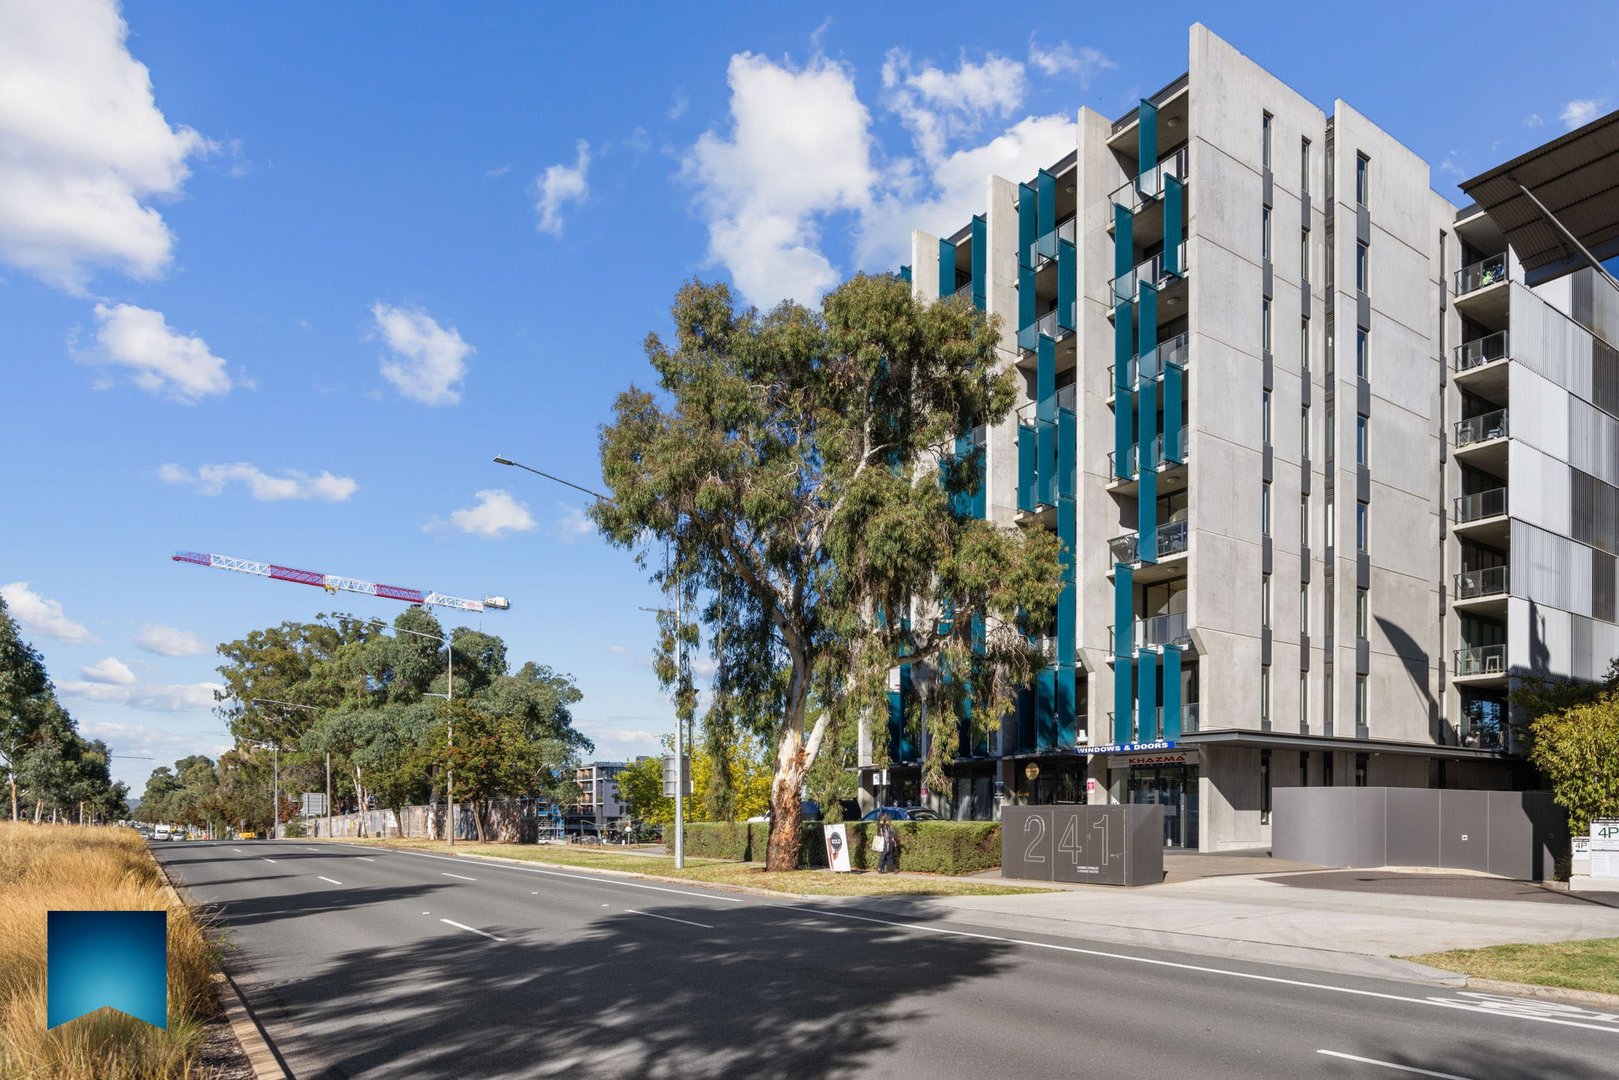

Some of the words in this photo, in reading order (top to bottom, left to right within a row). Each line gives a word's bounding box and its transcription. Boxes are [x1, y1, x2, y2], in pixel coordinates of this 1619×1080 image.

[1077, 745, 1121, 753] WINDOWS
[1134, 742, 1168, 750] DOORS
[1129, 756, 1185, 764] KHAZMA
[1598, 827, 1619, 838] 4P
[1024, 814, 1109, 866] 241
